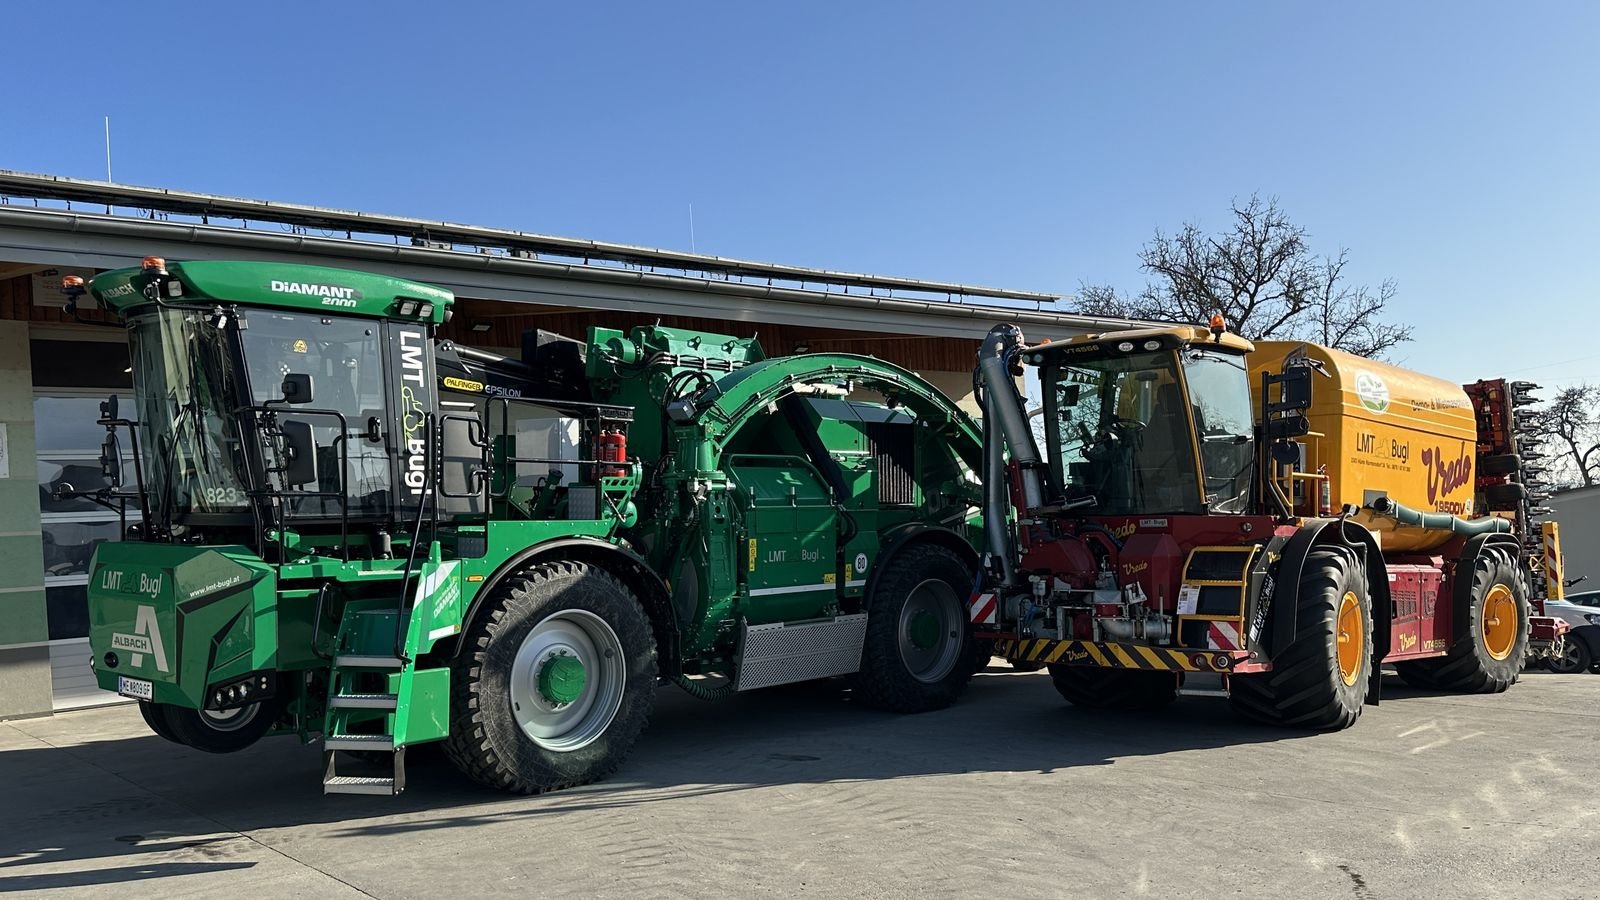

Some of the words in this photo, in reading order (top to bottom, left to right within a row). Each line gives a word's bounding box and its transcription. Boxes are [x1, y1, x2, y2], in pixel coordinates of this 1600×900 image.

[321, 297, 357, 308] 2000
[400, 330, 424, 388] LMT
[485, 384, 521, 398] EPSILON
[1356, 432, 1376, 454] LMT
[1391, 438, 1410, 464] Bugl
[404, 438, 432, 495] Bugl
[1421, 441, 1472, 506] Vredo
[207, 487, 237, 504] 823
[1434, 500, 1466, 516] 19500V
[768, 550, 787, 562] LMT
[802, 548, 819, 562] Bugl
[857, 557, 866, 570] 80
[1122, 560, 1148, 575] Vredo
[102, 570, 123, 590] LMT
[139, 573, 162, 598] Bugl
[189, 575, 240, 598] www.lmt-bugl.at
[114, 636, 147, 650] ALBACH
[1399, 630, 1417, 652] Vredo
